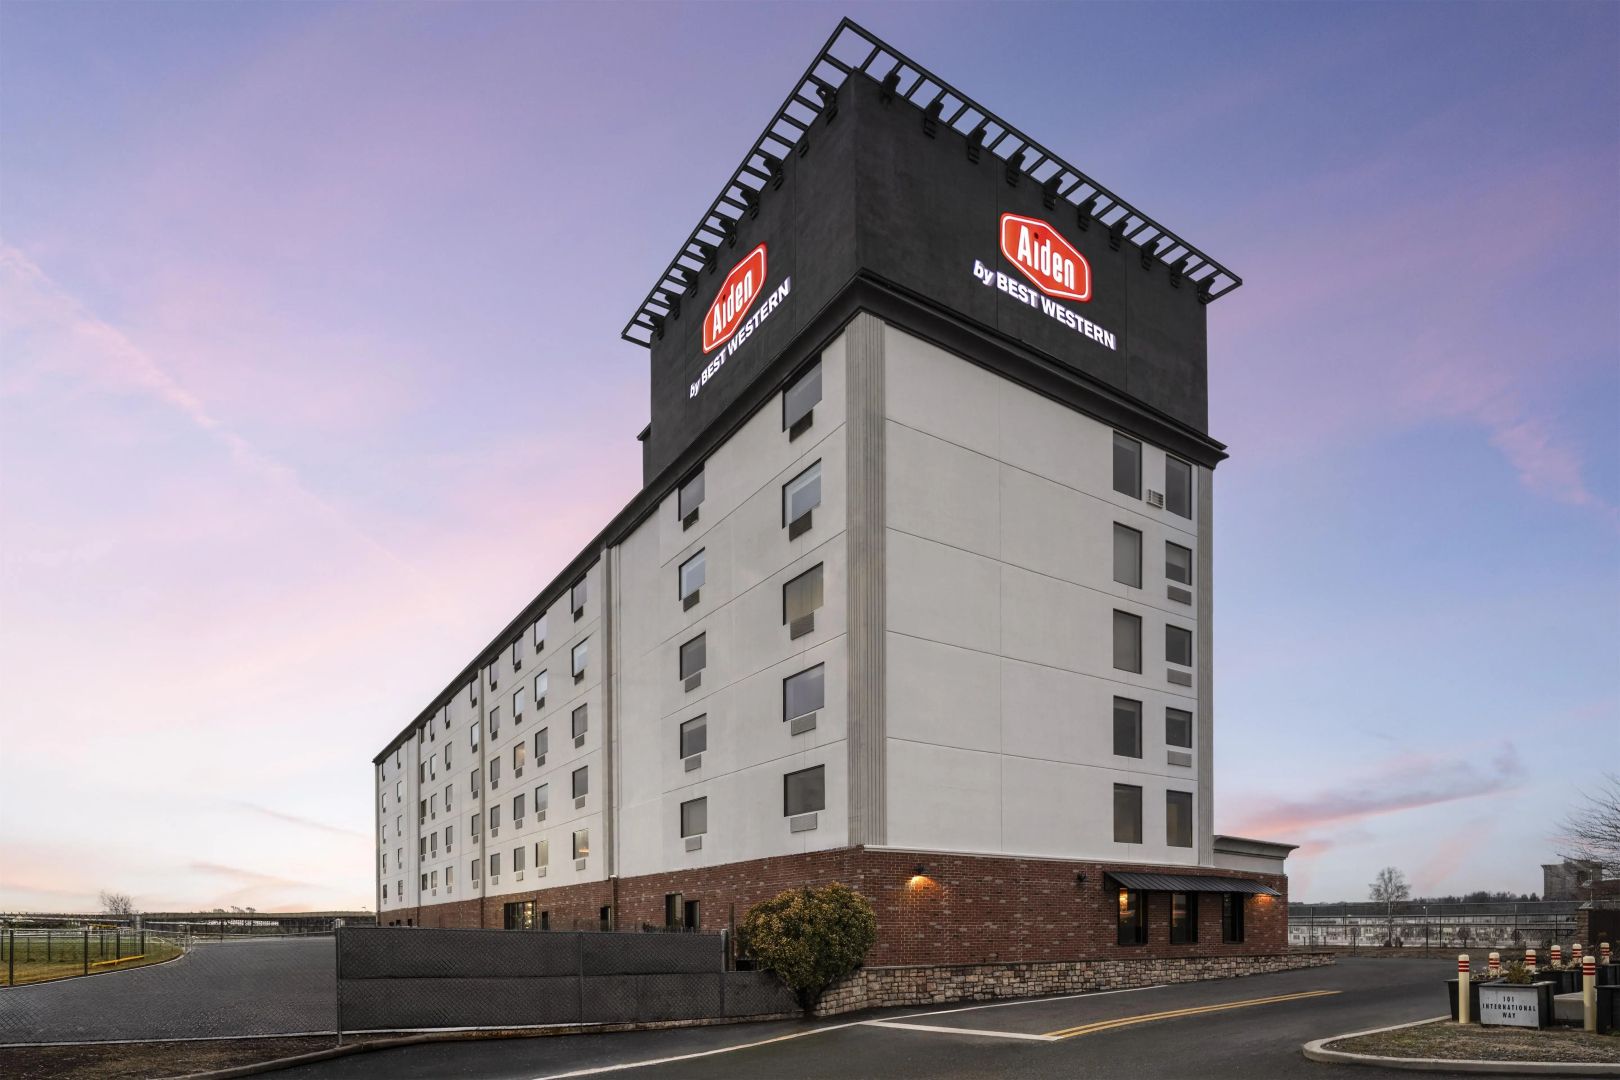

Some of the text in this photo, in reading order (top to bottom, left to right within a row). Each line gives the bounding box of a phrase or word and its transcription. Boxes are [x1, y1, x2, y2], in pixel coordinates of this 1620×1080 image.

[1017, 225, 1075, 291] Aiden
[689, 276, 791, 399] by BEST WESTERN
[712, 269, 753, 342] Aiden
[973, 259, 1116, 351] by BEST WESTERN
[1482, 1003, 1536, 1011] INTERNATIONAL
